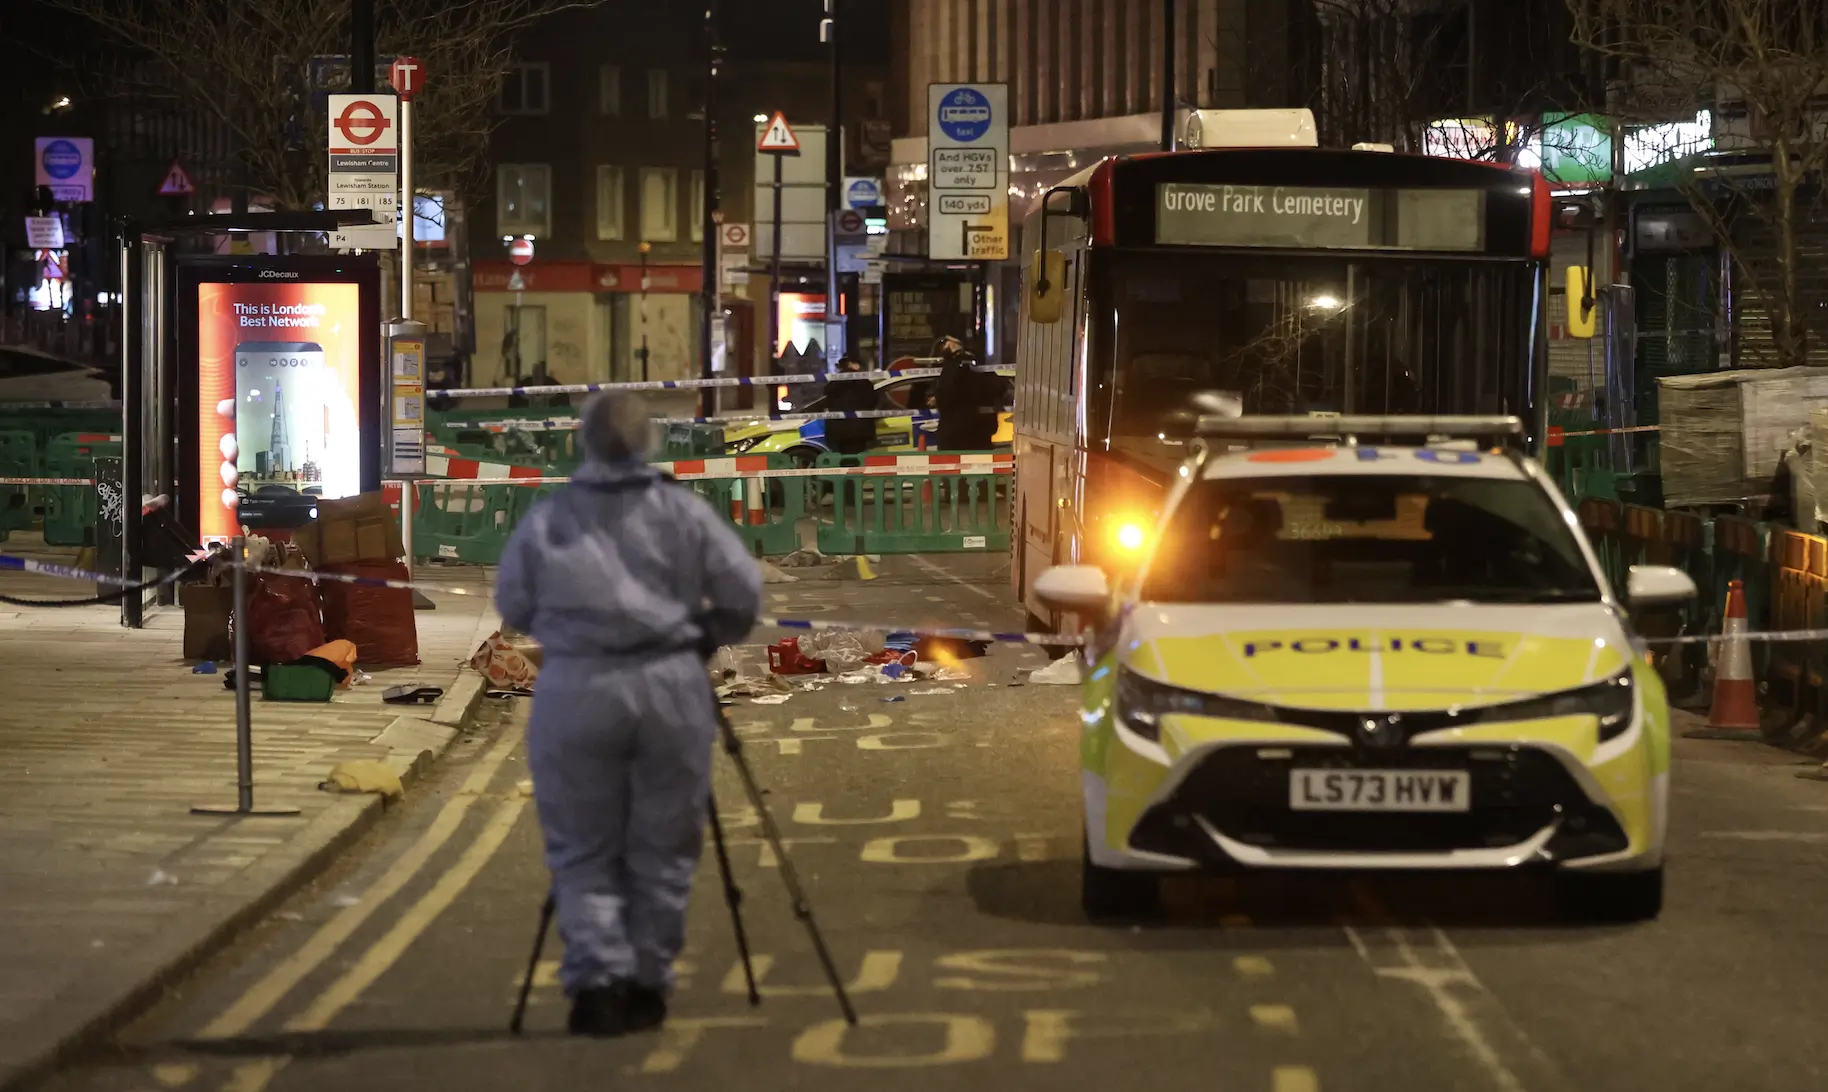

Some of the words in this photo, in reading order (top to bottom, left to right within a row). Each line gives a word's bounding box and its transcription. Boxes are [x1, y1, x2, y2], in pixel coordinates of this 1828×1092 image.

[397, 64, 418, 91] T
[939, 153, 960, 162] And
[963, 153, 992, 162] HGVs
[940, 165, 963, 173] over
[953, 177, 976, 186] only
[336, 197, 346, 205] 75
[357, 197, 370, 205] 181
[379, 197, 393, 205] 185
[945, 200, 964, 209] 140
[967, 200, 986, 211] yds
[1164, 183, 1216, 212] Grove
[1222, 185, 1265, 214] Park
[1272, 187, 1363, 225] Cemetery
[972, 234, 1004, 244] Other
[971, 246, 1005, 255] traffic
[258, 270, 299, 278] JCDecaux
[233, 303, 259, 315] This
[260, 303, 270, 315] is
[240, 316, 266, 327] Best
[1242, 636, 1506, 659] POLICE
[1302, 772, 1387, 804] LS73
[1395, 771, 1459, 803] HVW
